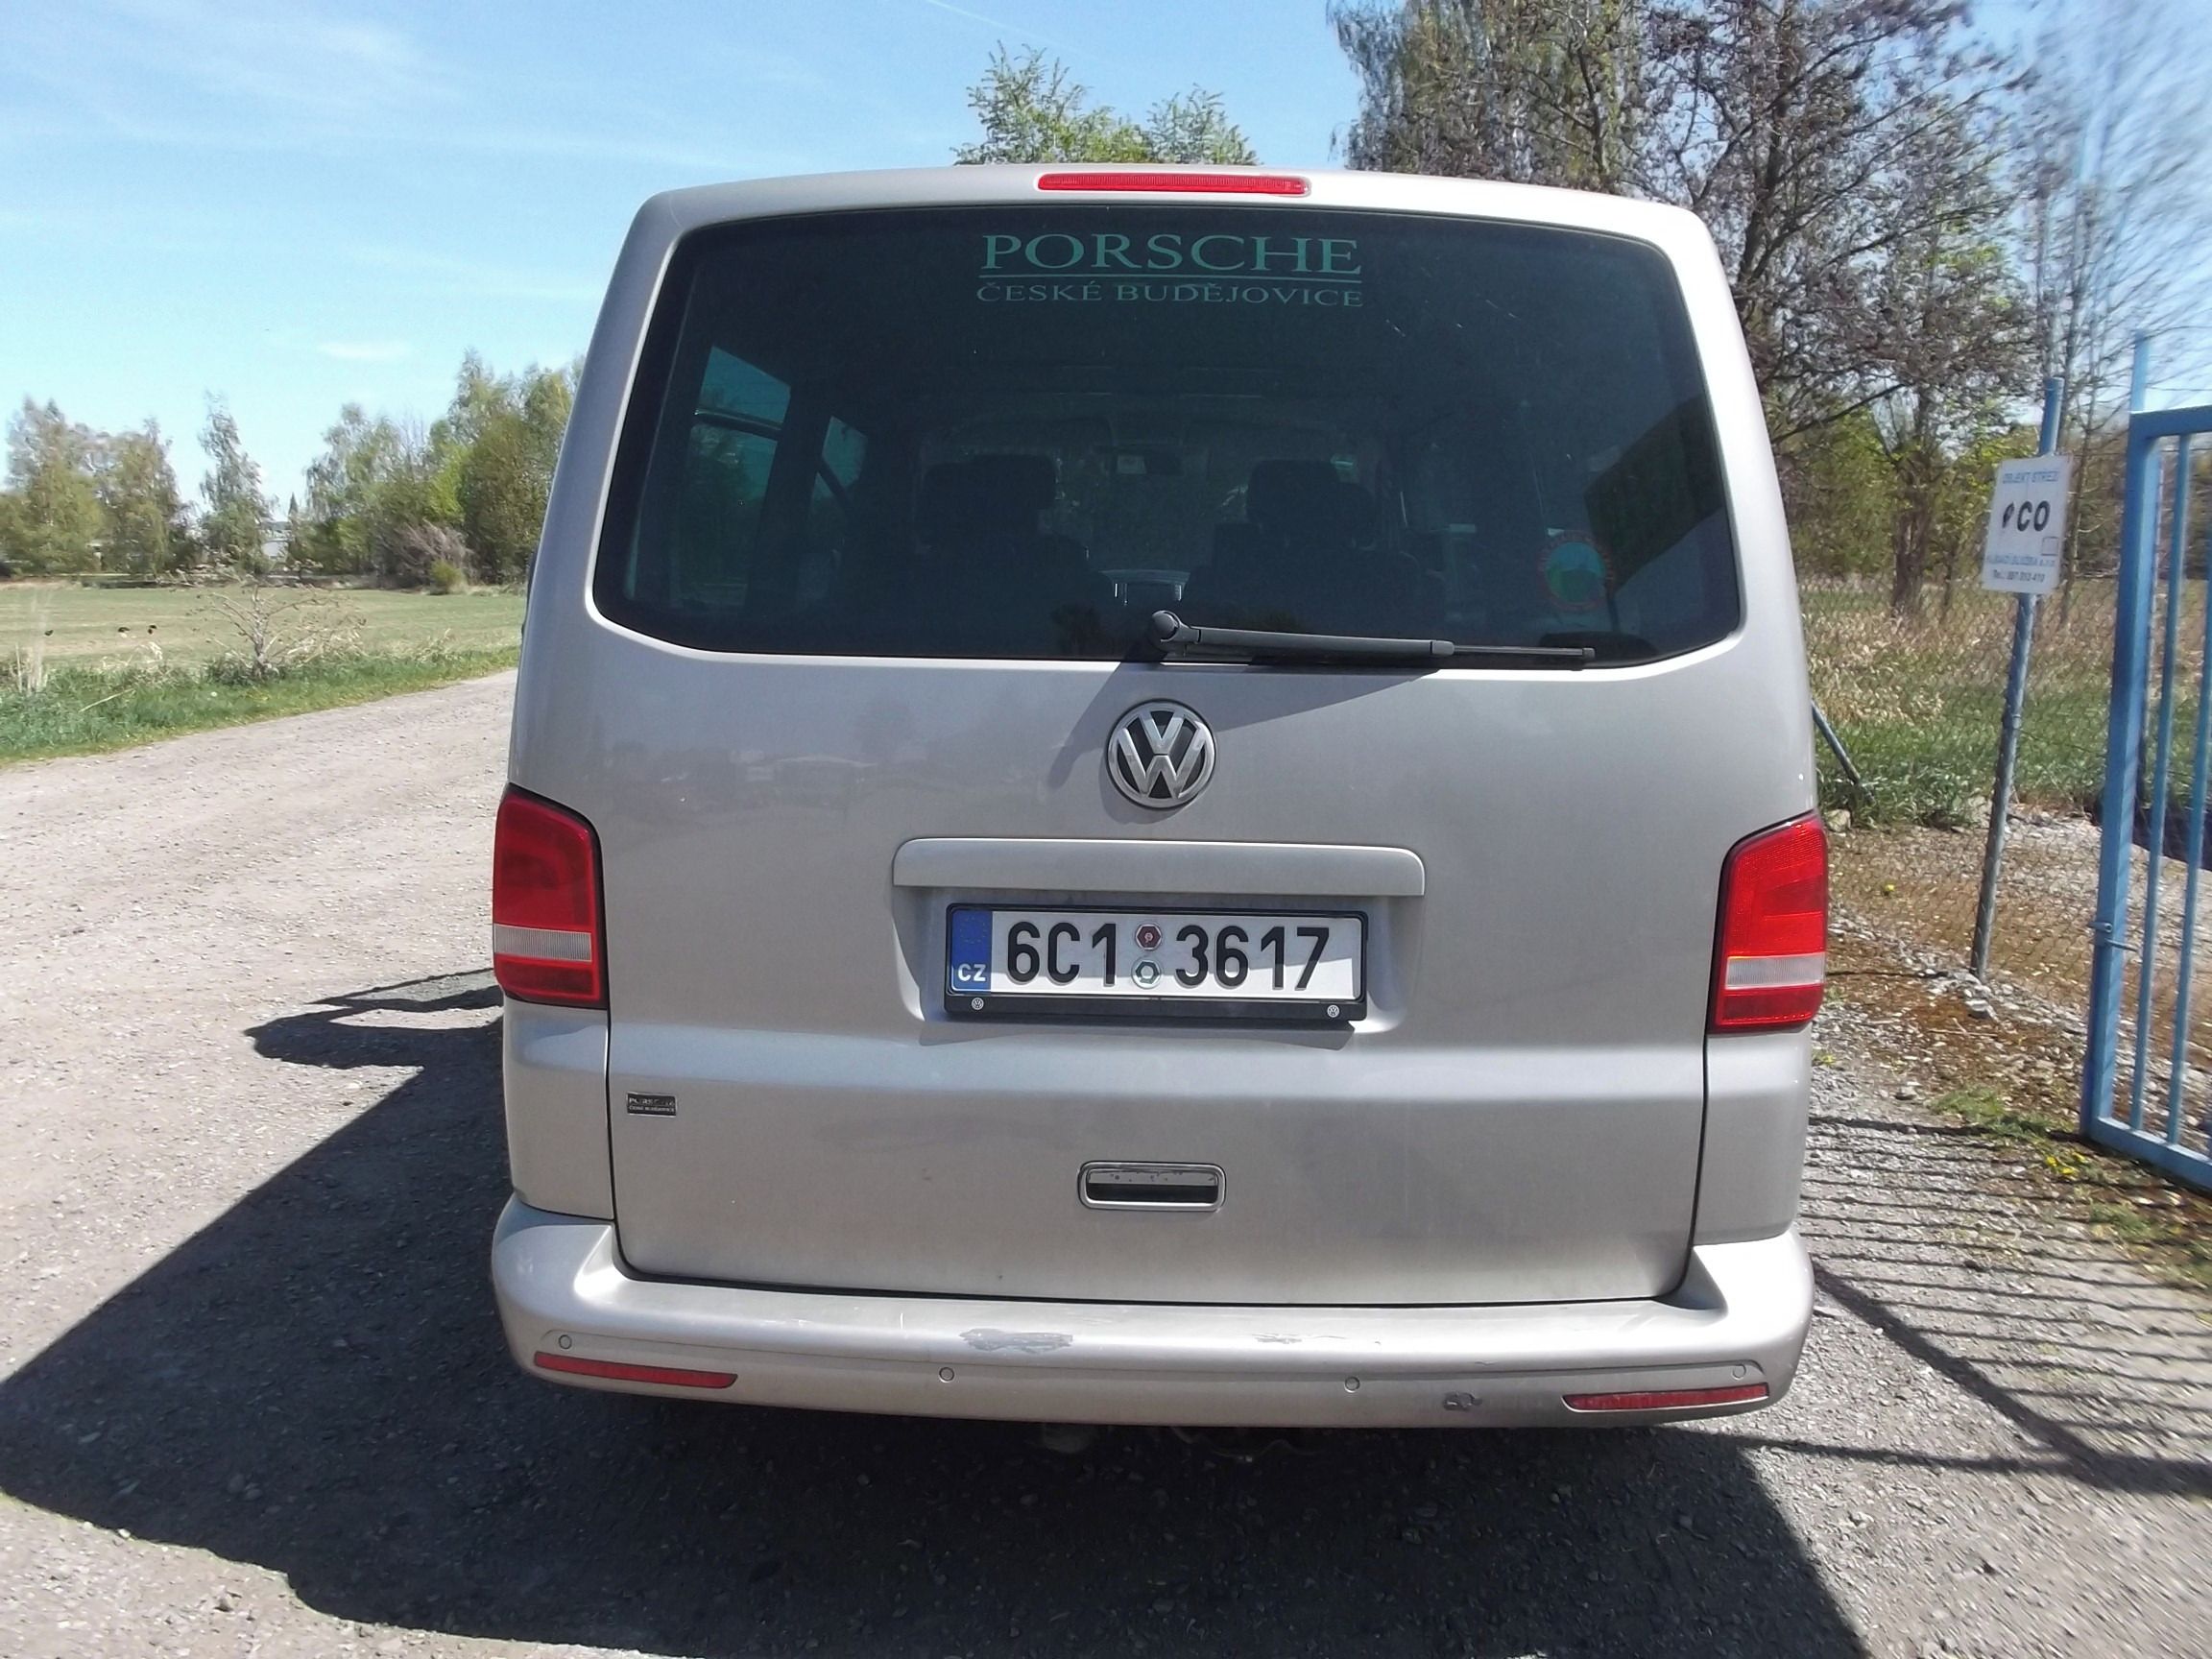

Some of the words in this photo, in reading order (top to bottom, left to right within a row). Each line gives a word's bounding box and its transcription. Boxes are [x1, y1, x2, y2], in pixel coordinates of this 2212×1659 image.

[981, 233, 1362, 275] PORSCHE
[976, 280, 1101, 301] ČESKÉ
[1117, 283, 1364, 307] BUDĚJOVICE
[957, 963, 987, 982] CZ
[1006, 921, 1118, 986] 6C1
[1174, 924, 1331, 991] 3617
